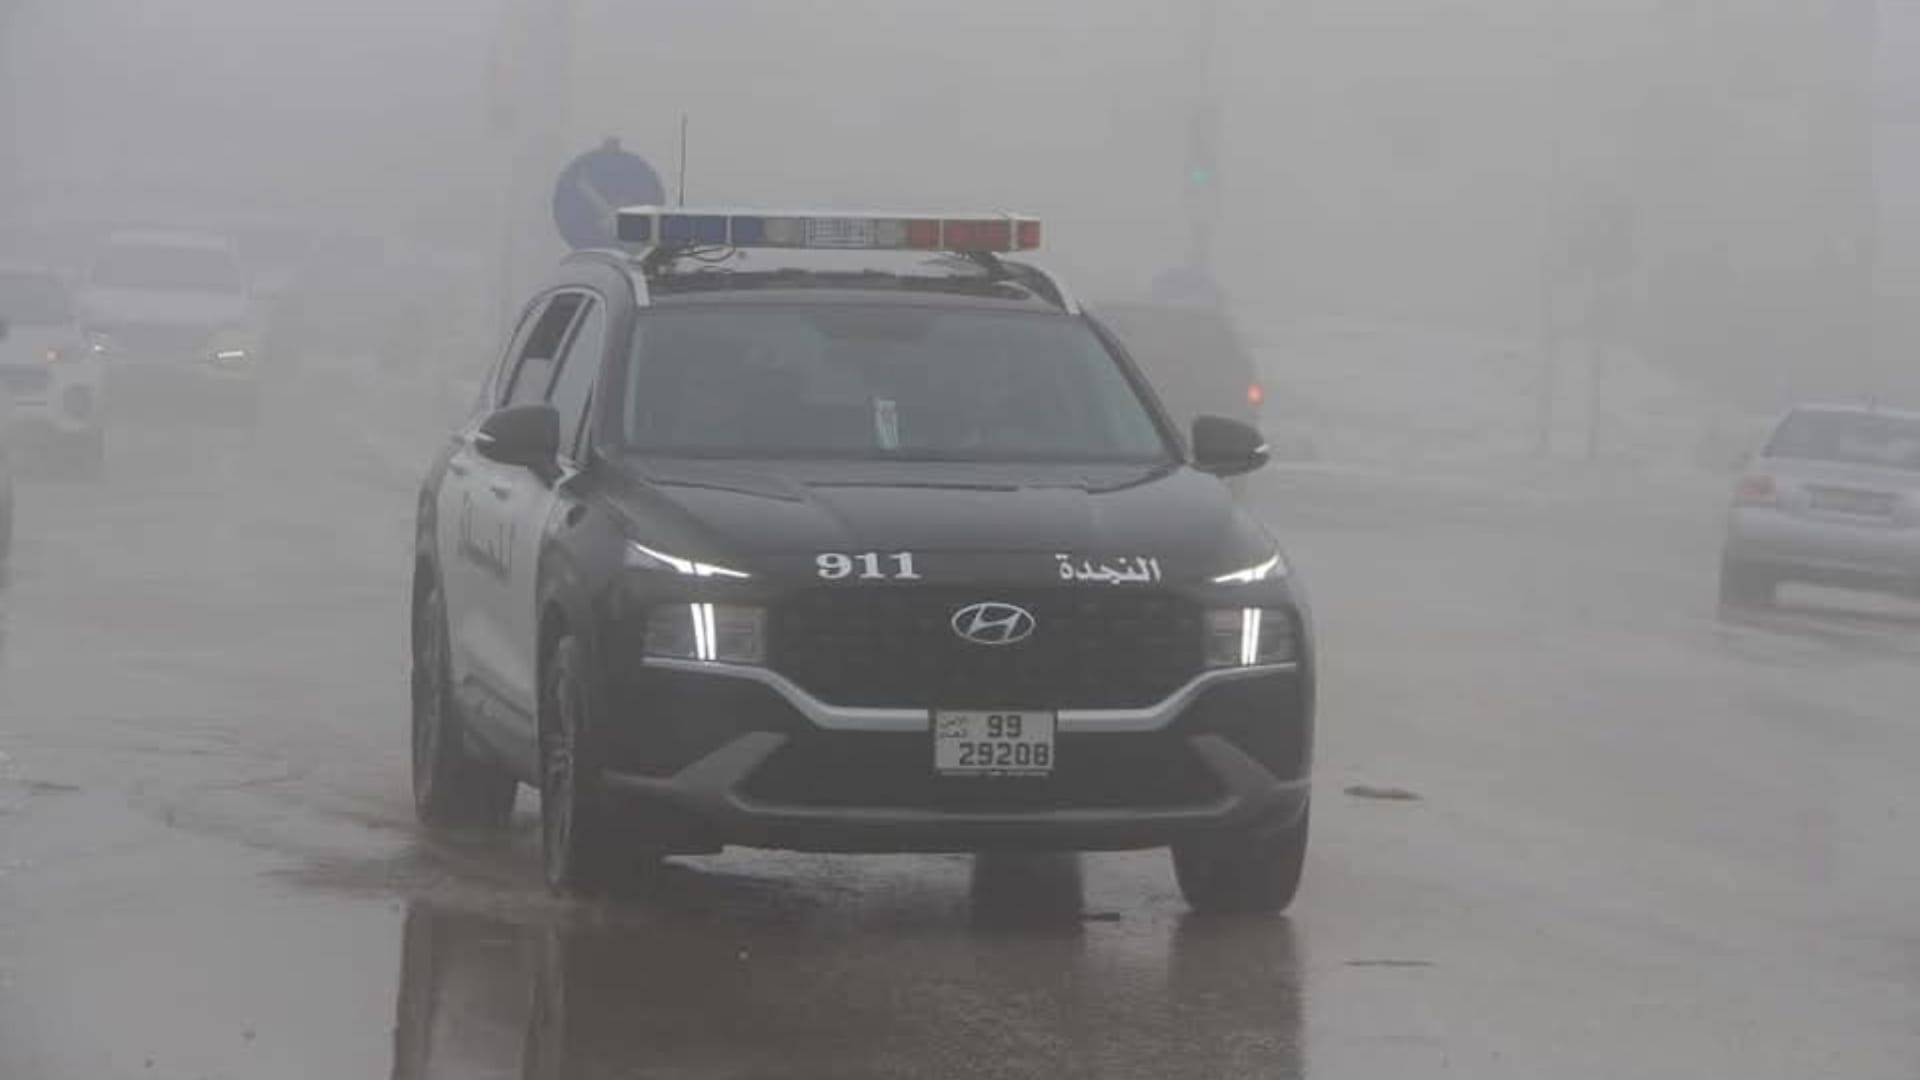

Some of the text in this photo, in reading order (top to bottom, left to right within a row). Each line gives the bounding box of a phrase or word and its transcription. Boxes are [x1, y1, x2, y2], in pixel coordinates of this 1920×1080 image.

[815, 551, 922, 580] 911
[1055, 553, 1161, 584] النجدة
[986, 714, 1022, 738] 99
[958, 743, 1049, 766] 29208
